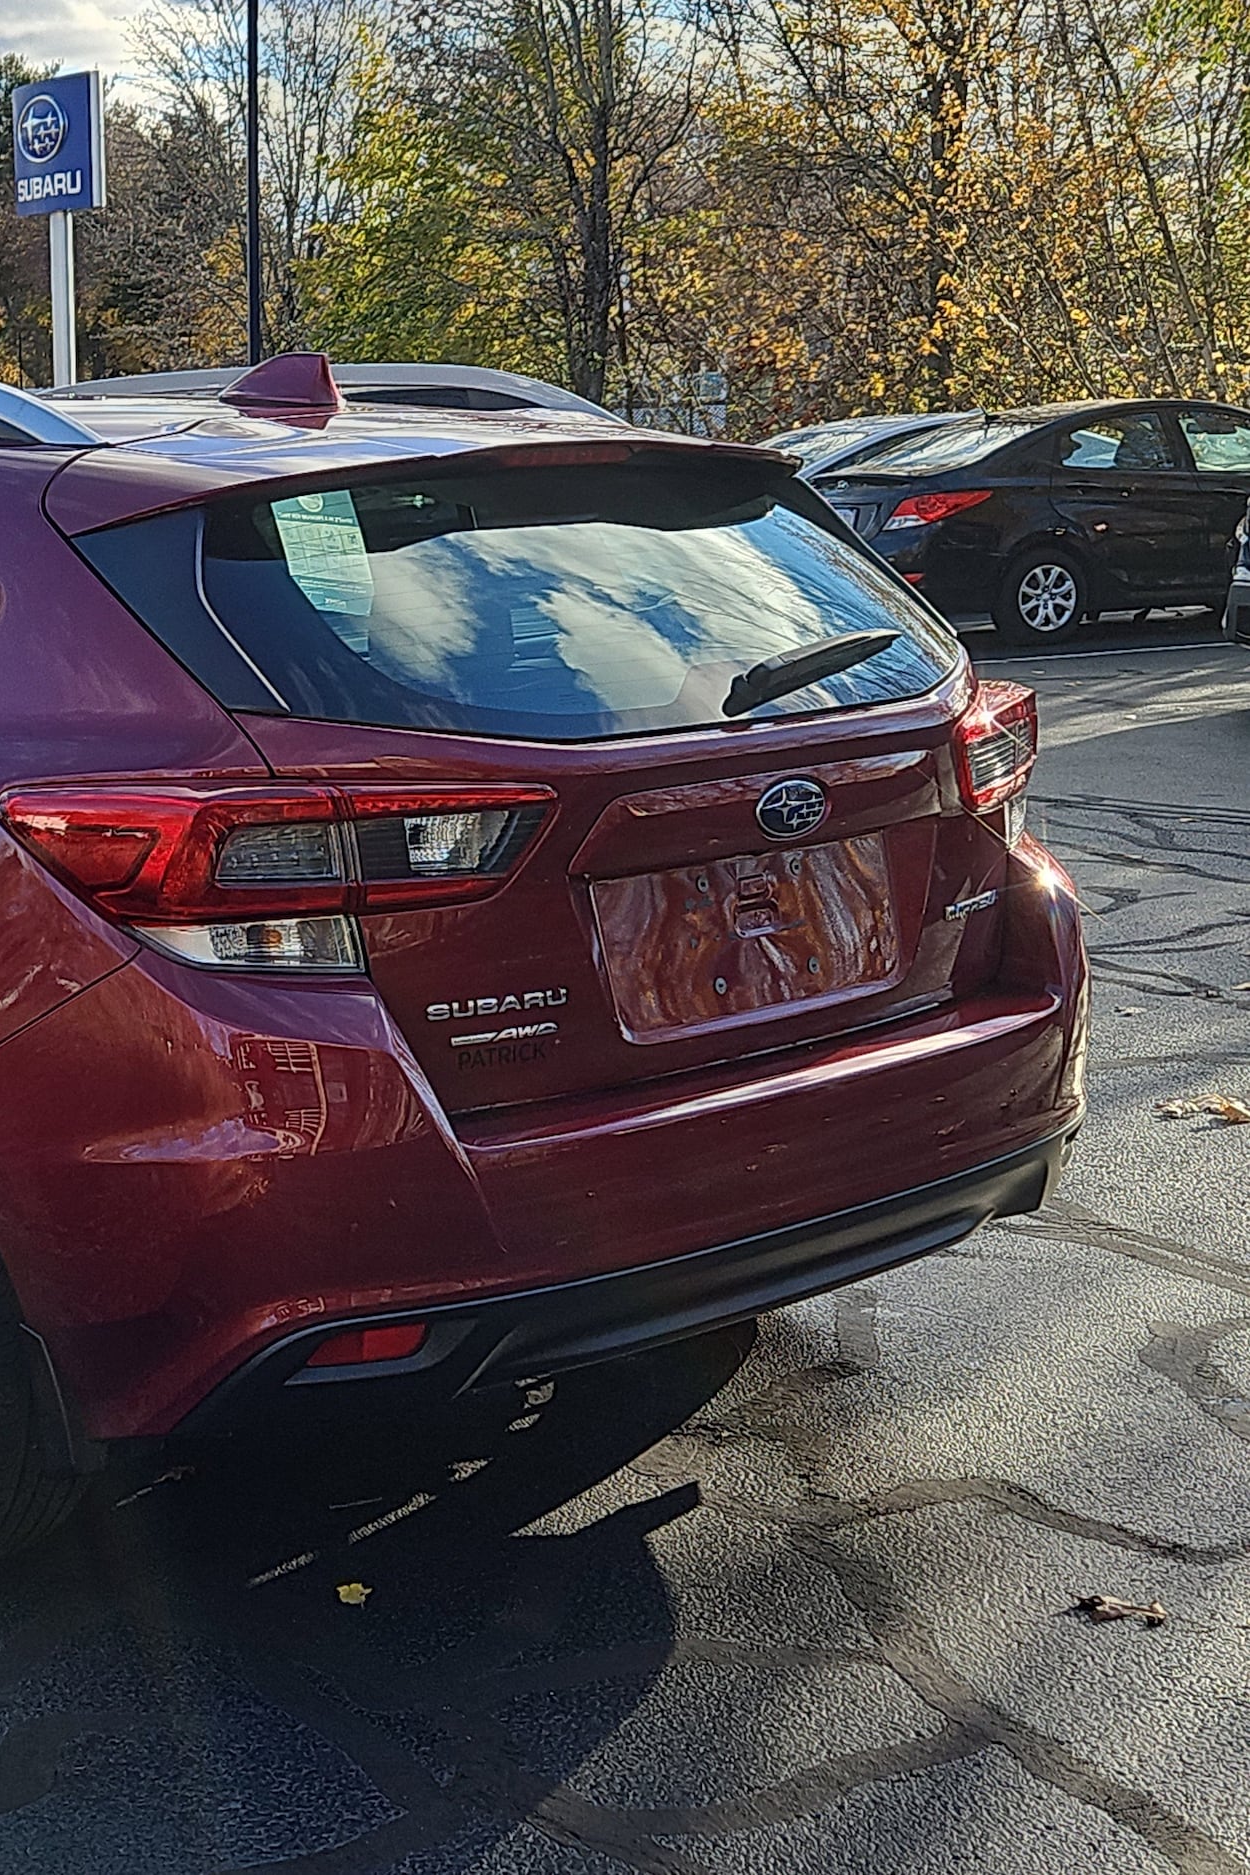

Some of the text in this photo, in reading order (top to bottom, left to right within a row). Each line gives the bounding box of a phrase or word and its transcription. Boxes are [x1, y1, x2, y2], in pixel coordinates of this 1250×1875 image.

[17, 169, 82, 203] SUBARU
[426, 987, 568, 1022] SUBARU
[493, 1022, 559, 1043] AWD
[457, 1042, 547, 1071] PATRICK
